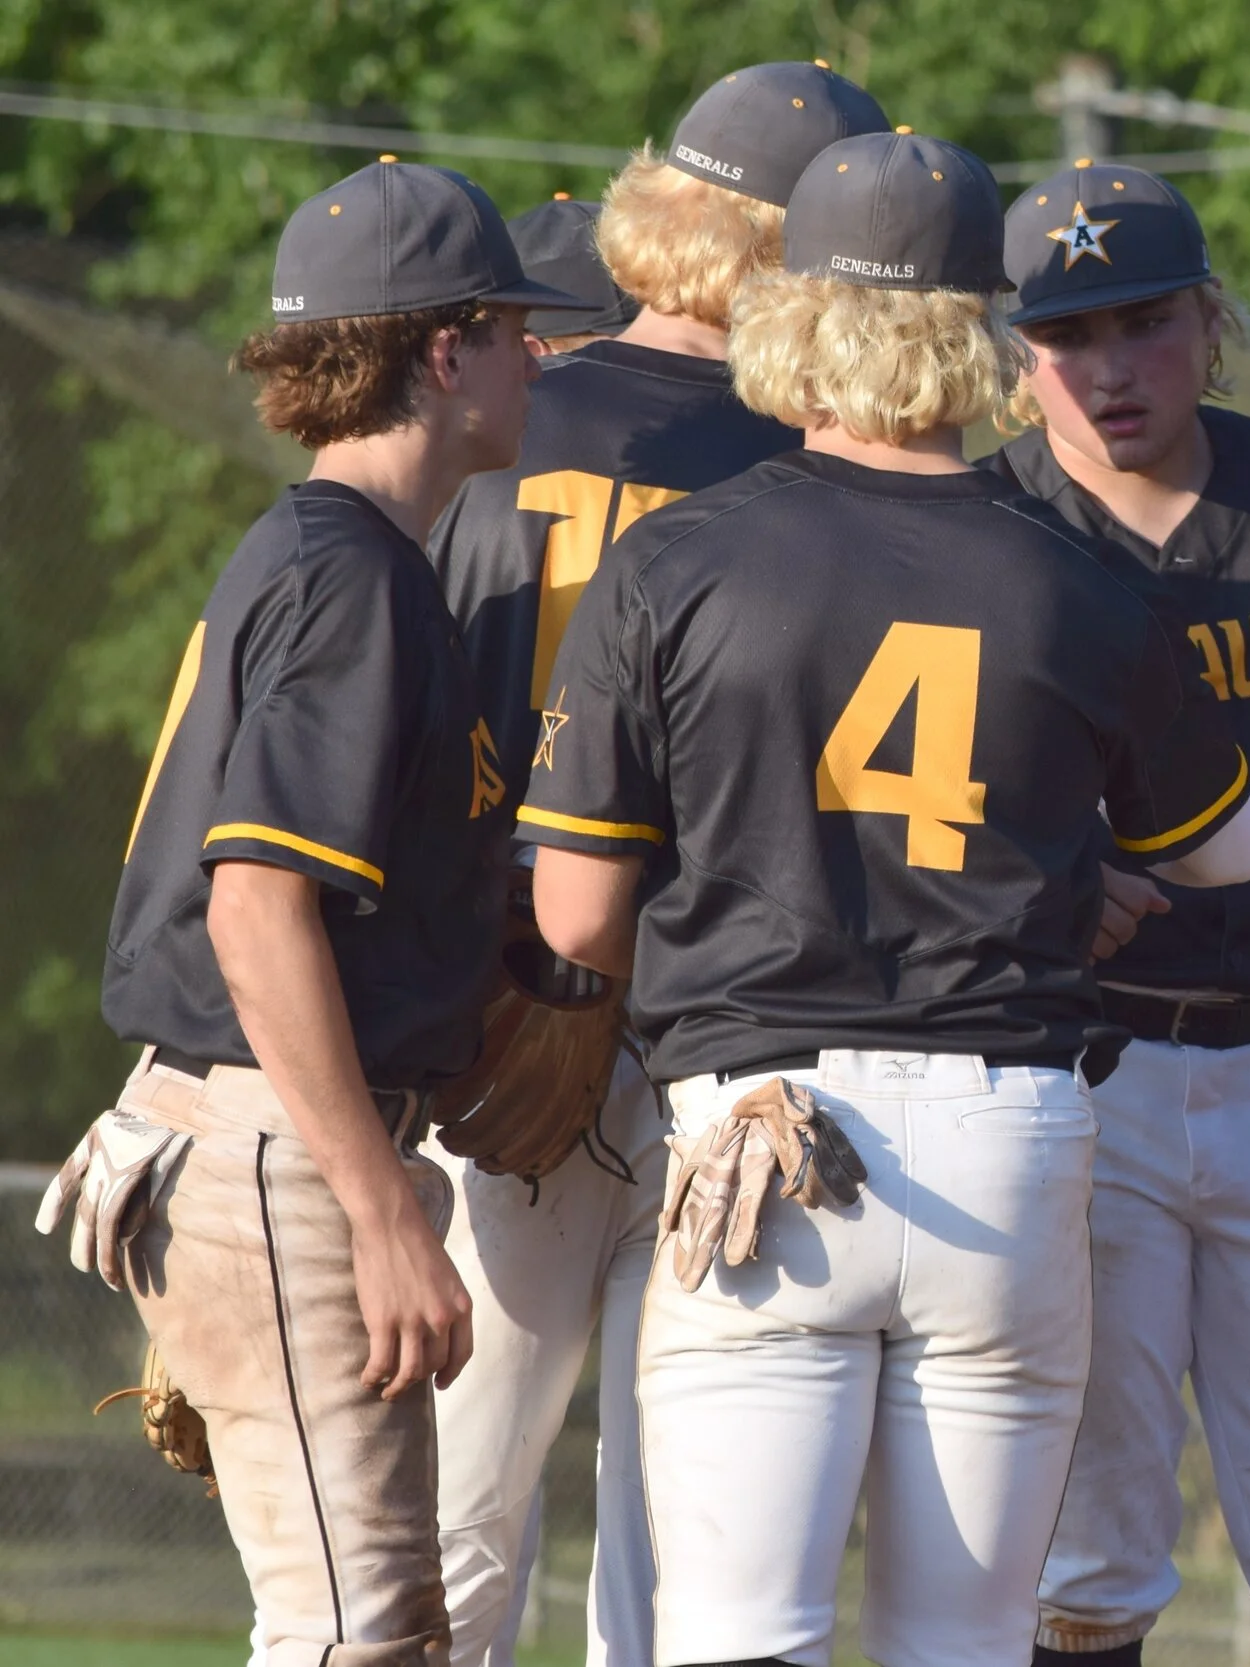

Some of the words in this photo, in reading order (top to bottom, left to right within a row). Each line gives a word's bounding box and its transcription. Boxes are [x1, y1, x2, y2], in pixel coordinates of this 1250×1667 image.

[676, 145, 743, 181] GENERALS
[1074, 225, 1095, 247] A
[831, 255, 915, 279] GENERALS
[816, 621, 986, 872] 4
